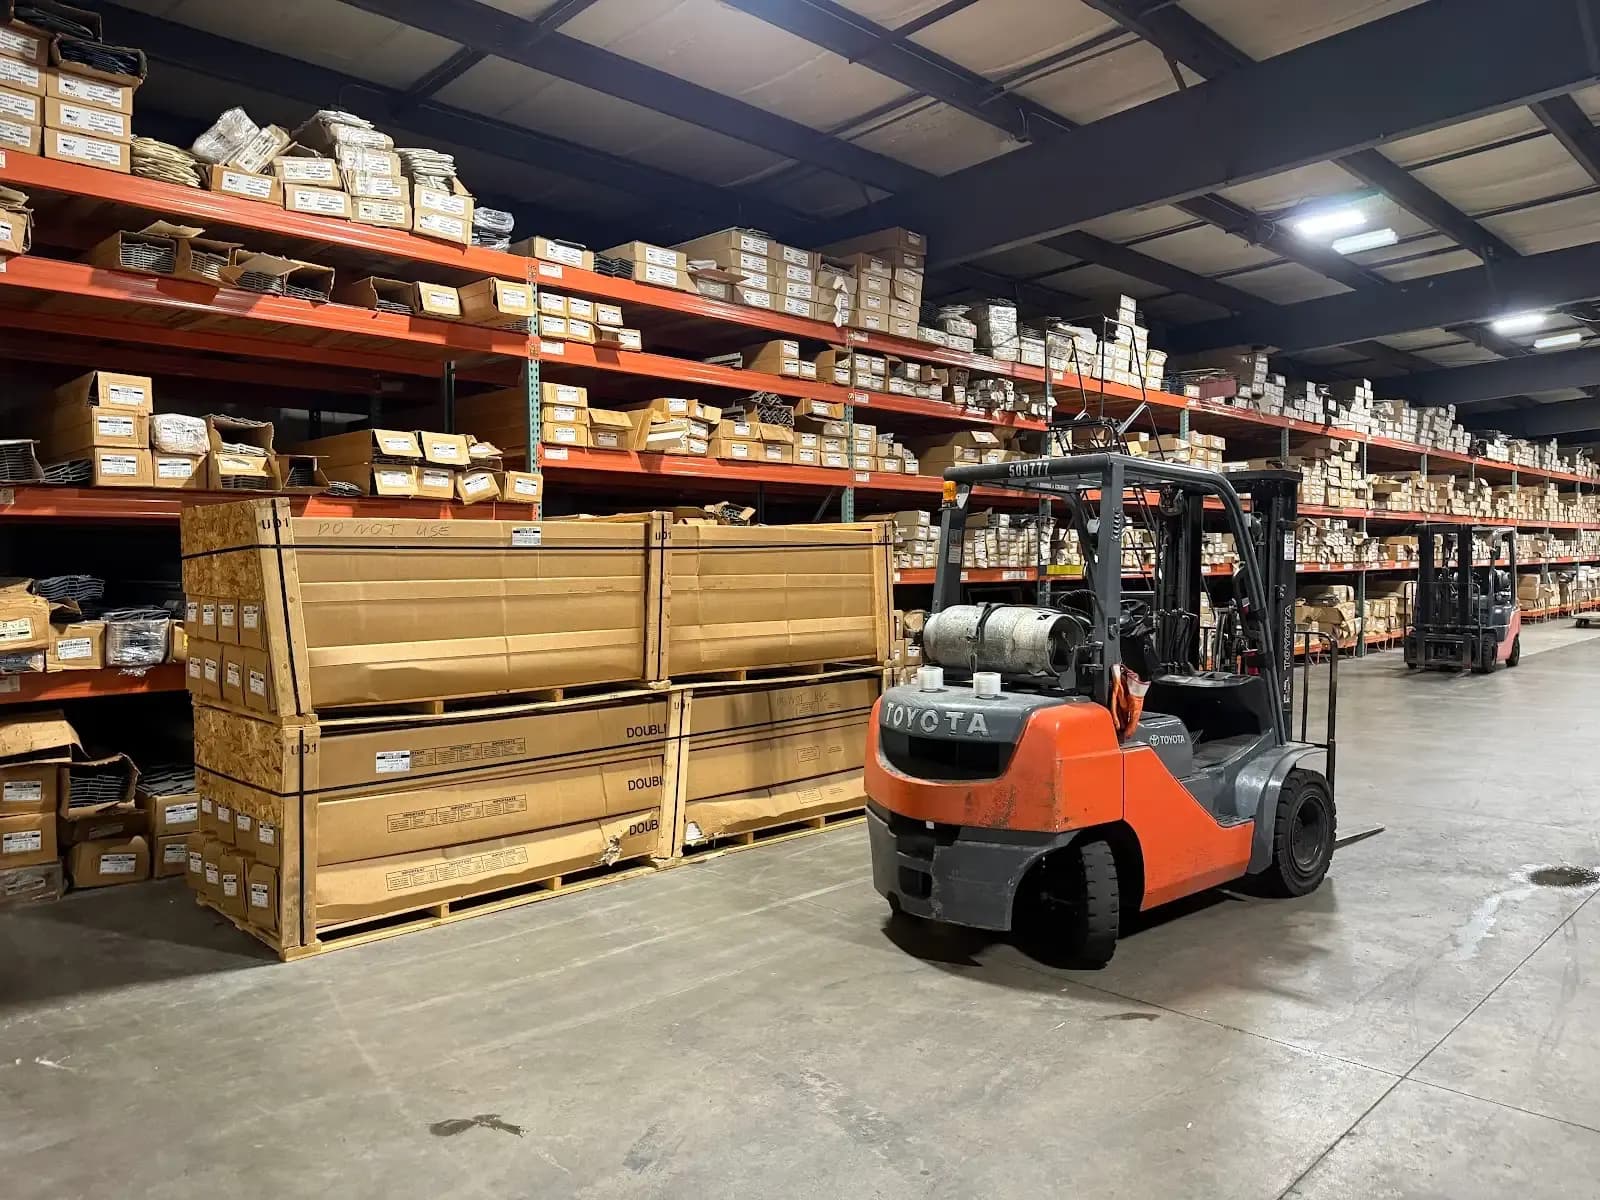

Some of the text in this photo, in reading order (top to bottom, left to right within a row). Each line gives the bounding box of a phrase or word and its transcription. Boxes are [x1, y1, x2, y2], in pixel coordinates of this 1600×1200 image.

[1009, 462, 1049, 477] 509777
[317, 523, 451, 538] DO NOT USE
[1283, 605, 1292, 671] TOYOTA
[886, 702, 992, 738] TOYOTA
[1160, 734, 1185, 745] TOYOTA
